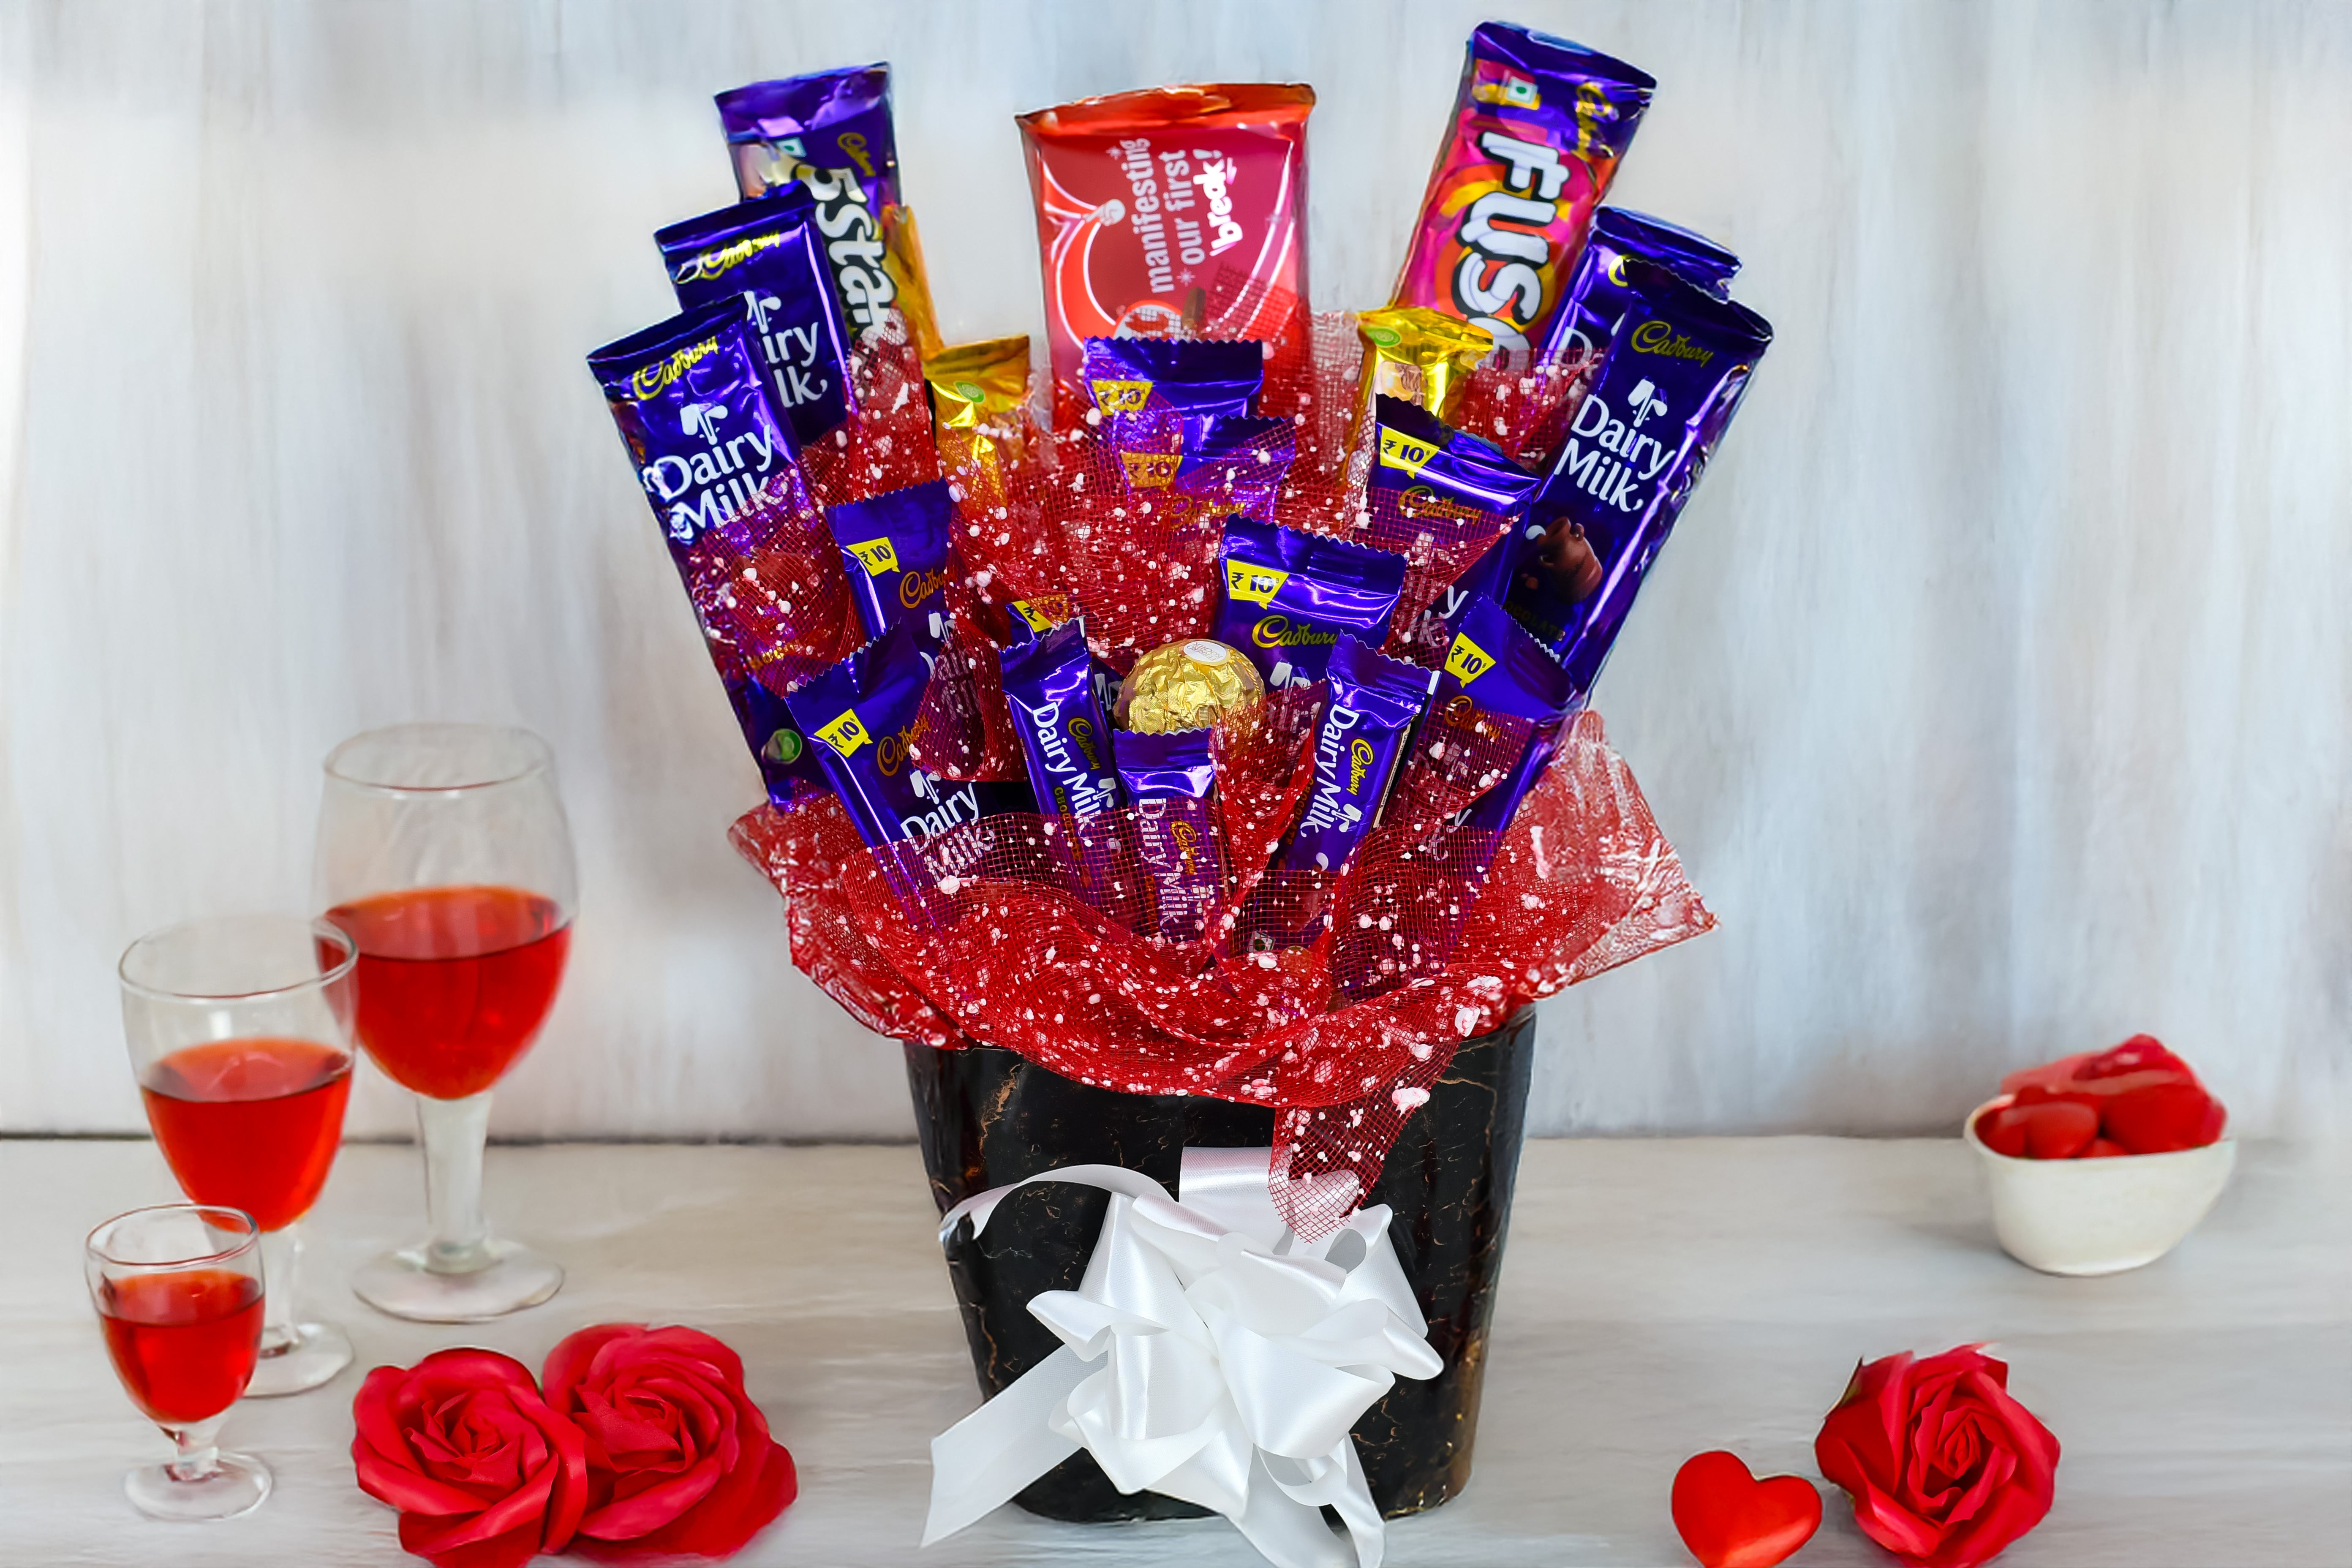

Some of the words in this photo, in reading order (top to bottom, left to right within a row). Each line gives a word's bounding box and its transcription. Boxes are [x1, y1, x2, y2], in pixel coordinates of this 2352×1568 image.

[1158, 150, 1195, 212] first
[1120, 137, 1175, 294] manifesting
[1175, 218, 1206, 265] our
[632, 336, 719, 400] Cadbury
[764, 322, 819, 367] iry
[1631, 320, 1714, 368] Cadbury
[773, 367, 828, 408] lk
[642, 424, 774, 501] Dairy
[1571, 393, 1676, 480] Dairy
[1553, 438, 1643, 512] Milk
[670, 472, 788, 545] Milk
[1067, 717, 1101, 770] Cadbury
[1315, 703, 1360, 788] Dairy
[1346, 738, 1374, 795] Cadbury
[900, 782, 979, 856] Dairy
